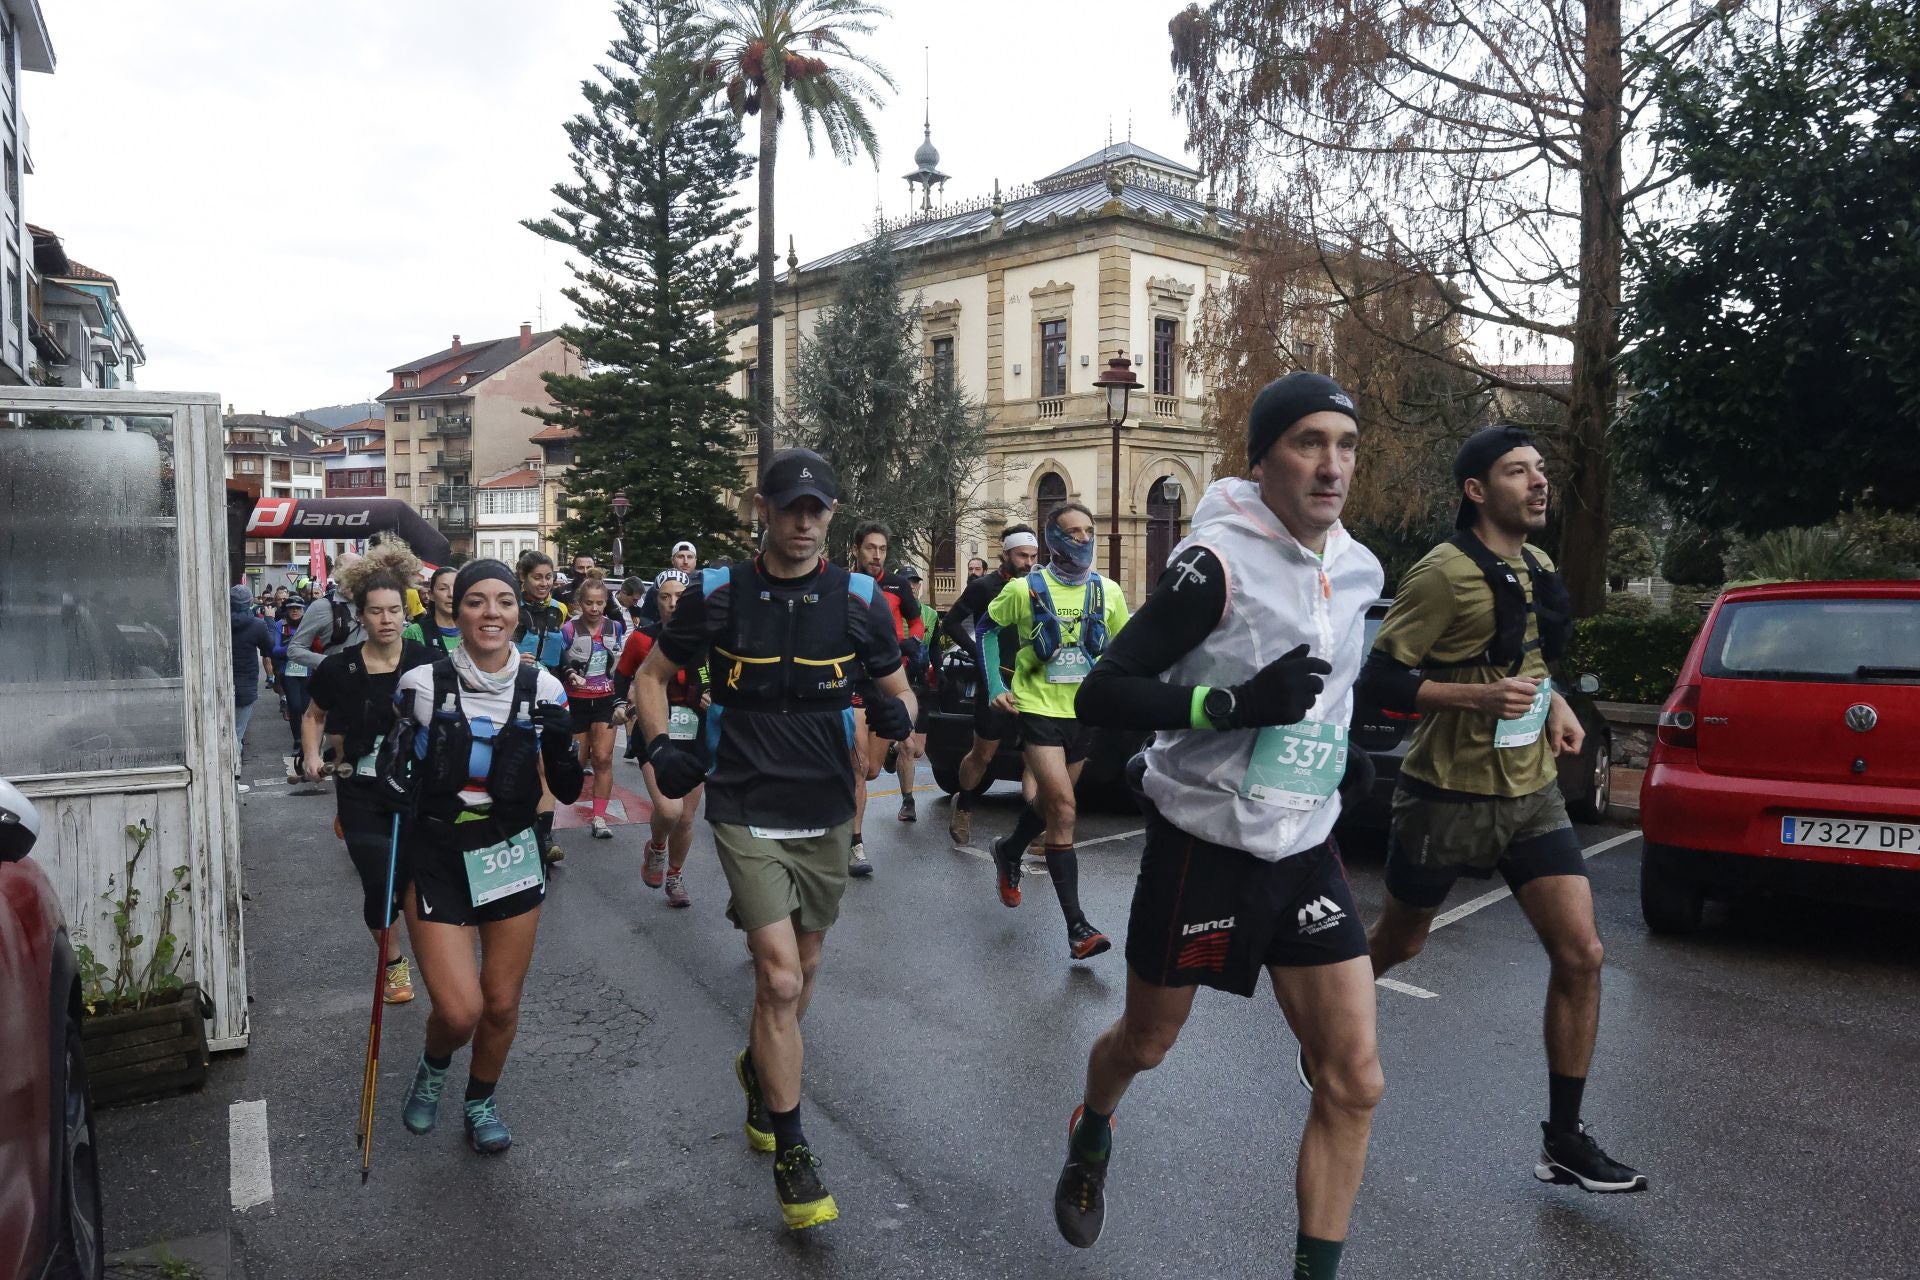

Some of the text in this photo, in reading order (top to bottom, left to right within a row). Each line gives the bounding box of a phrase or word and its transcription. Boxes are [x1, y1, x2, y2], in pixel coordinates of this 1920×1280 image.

[293, 509, 370, 526] land
[1703, 717, 1728, 725] FOX
[1277, 736, 1333, 769] 337
[1800, 821, 1920, 850] 7327 DP
[481, 844, 525, 874] 309
[1182, 916, 1236, 936] land
